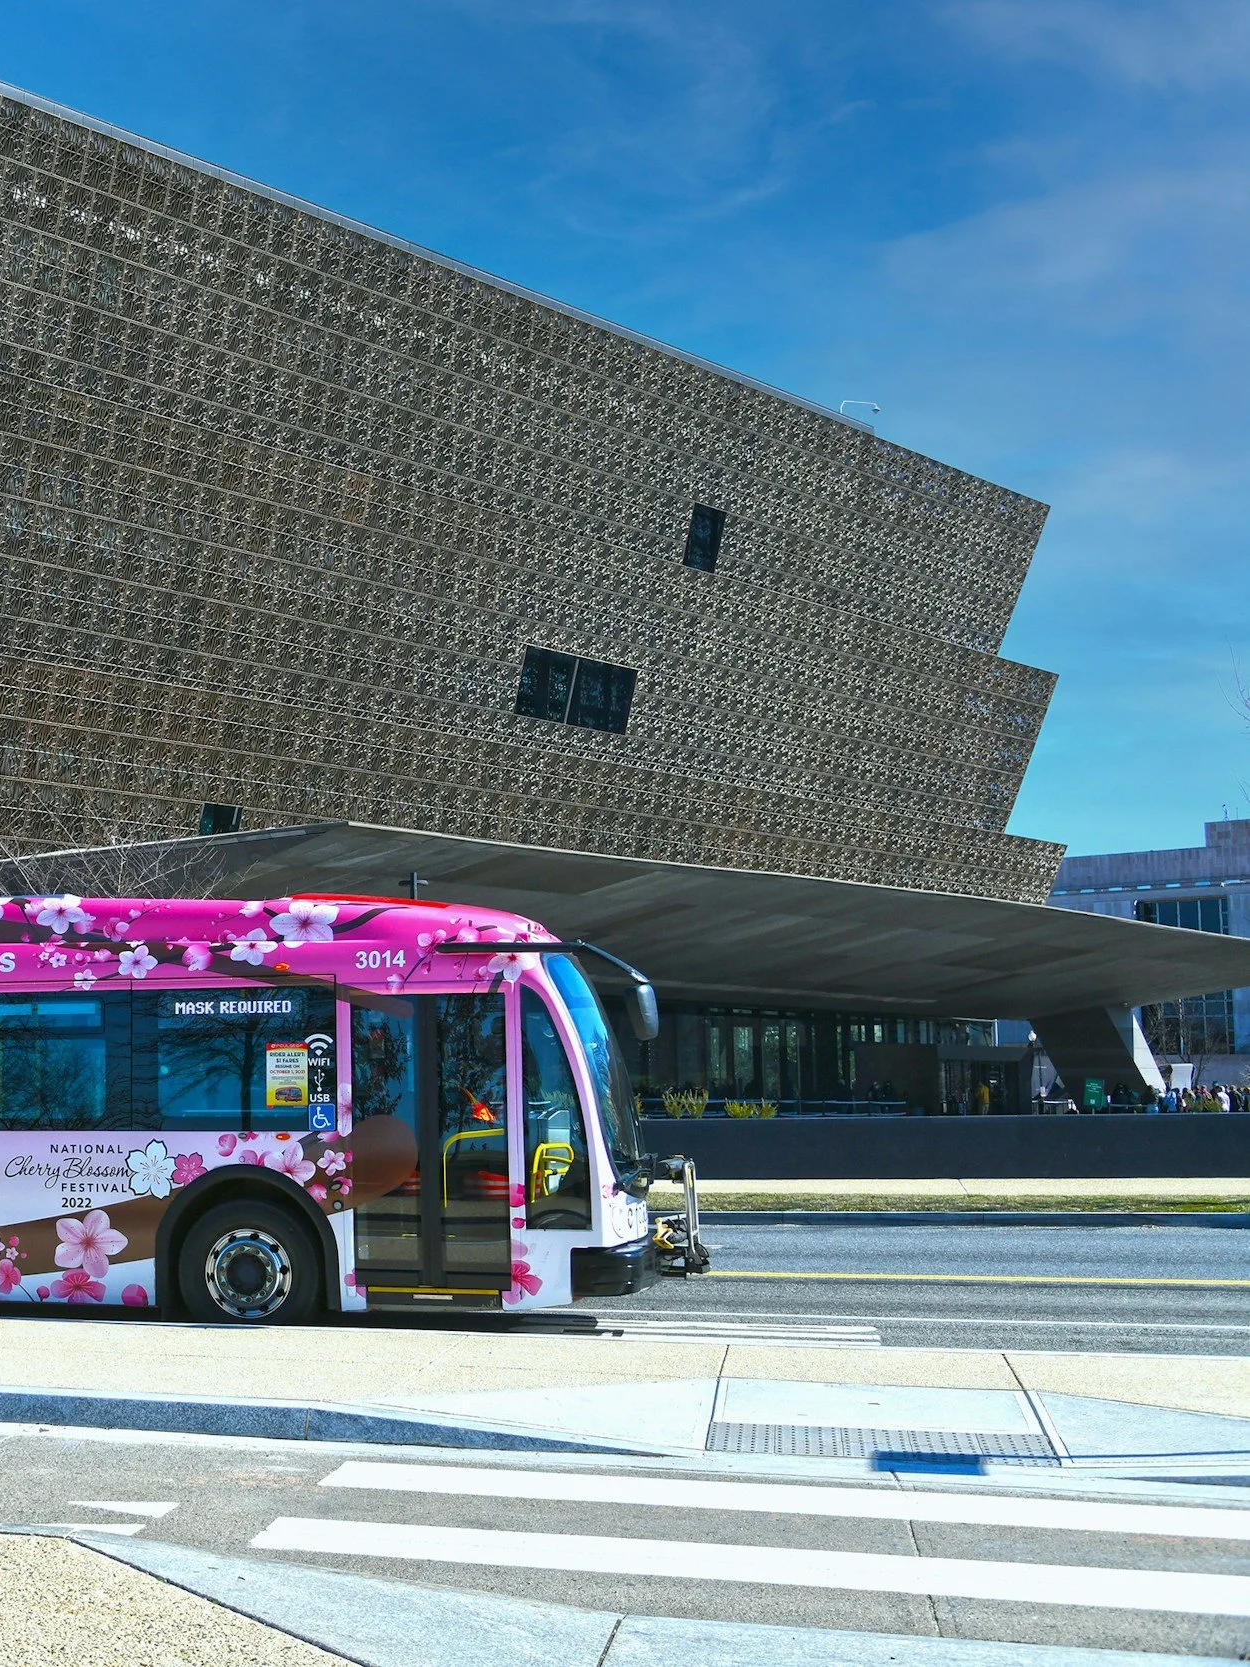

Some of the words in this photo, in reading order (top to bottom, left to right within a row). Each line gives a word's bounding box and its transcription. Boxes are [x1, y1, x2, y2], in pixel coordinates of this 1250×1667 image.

[355, 950, 406, 969] 3014
[175, 1001, 215, 1014] MASK
[219, 1000, 292, 1014] REQUIRED
[308, 1057, 330, 1066] WIFI
[310, 1093, 330, 1102] USB
[50, 1144, 123, 1154] NATIONAL
[4, 1155, 60, 1189] Cherry
[62, 1156, 130, 1179] Blossom
[61, 1182, 127, 1193] FESTIVAL
[61, 1197, 92, 1208] 2022
